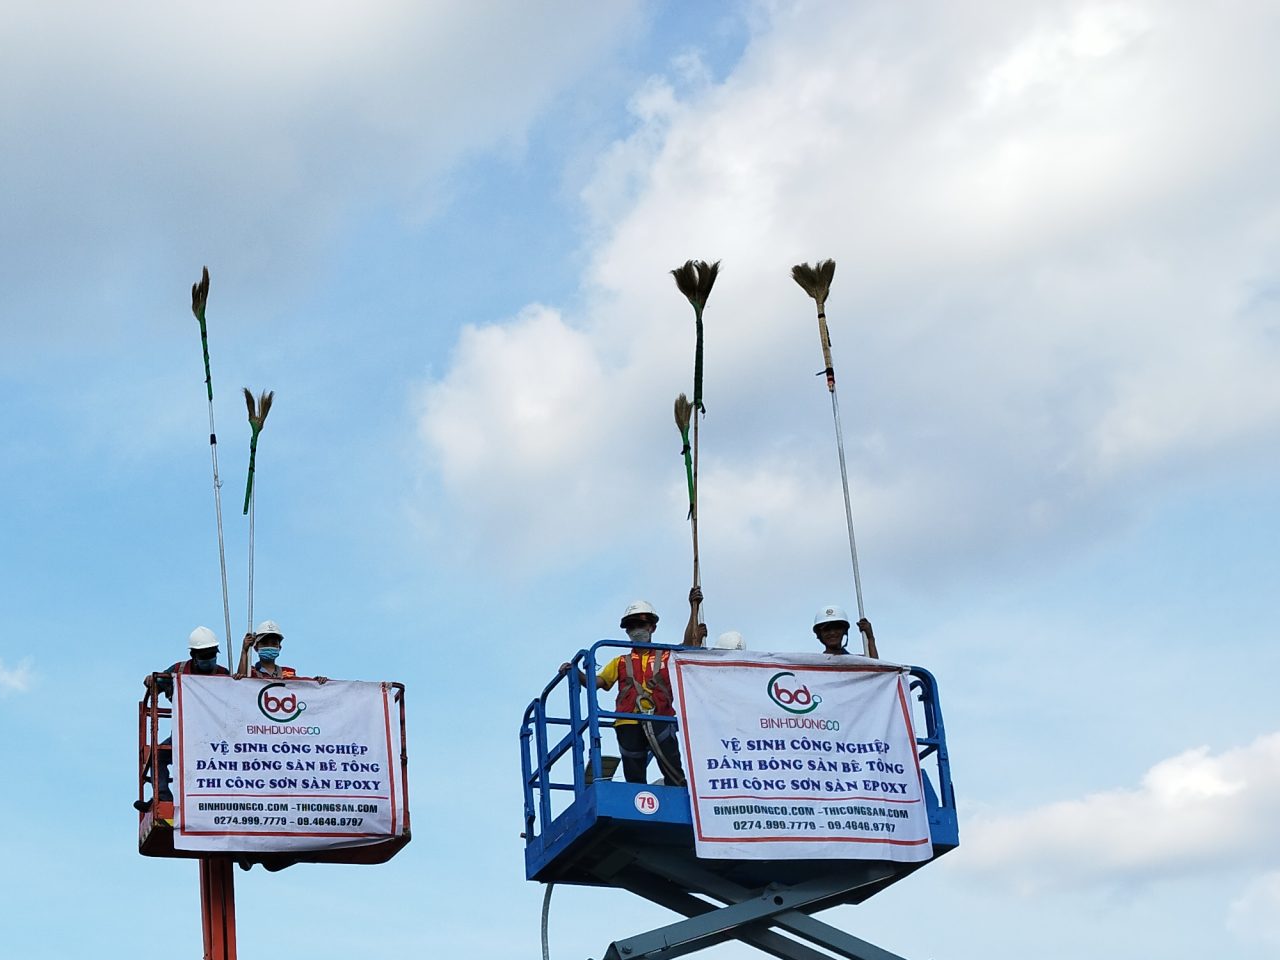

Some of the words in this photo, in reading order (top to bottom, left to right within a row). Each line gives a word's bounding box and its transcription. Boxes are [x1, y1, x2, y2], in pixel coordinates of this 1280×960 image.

[247, 725, 321, 735] BINHDUONGCO
[760, 718, 840, 731] BINHDUONGCO
[210, 740, 229, 755] VỆ
[233, 743, 268, 753] SINH
[272, 741, 311, 753] CÔNG
[315, 743, 368, 756] NGHIỆP
[721, 737, 741, 753] VỆ
[746, 739, 786, 751] SINH
[790, 736, 832, 752] CÔNG
[836, 739, 890, 754] NGHIỆP
[196, 758, 238, 771] ĐÁNH
[242, 758, 282, 771] BÓNG
[286, 759, 315, 771] SÀN
[319, 759, 337, 772] BÊ
[341, 760, 380, 773] TÔNG
[707, 755, 753, 771] ĐÁNH
[757, 756, 803, 770] BÓNG
[807, 757, 838, 772] SÀN
[841, 760, 862, 773] BÊ
[866, 758, 904, 774] TÔNG
[196, 778, 221, 788] THI
[225, 776, 265, 789] CÔNG
[269, 776, 298, 789] SƠN
[301, 776, 331, 789] SÀN
[334, 779, 381, 790] EPOXY
[709, 778, 738, 790] THI
[742, 777, 786, 790] CÔNG
[790, 777, 820, 791] SƠN
[825, 778, 858, 792] SÀN
[862, 780, 908, 794] EPOXY
[198, 802, 288, 812] BINHDUONGCO.COM
[639, 797, 655, 809] 79
[713, 805, 815, 816] BINHDUONGCO.COM
[214, 816, 287, 825] 0274.999.7779
[297, 817, 363, 827] 09.4646.9797
[733, 820, 816, 830] 0274.999.7779
[827, 821, 896, 833] 09.4646.9797
